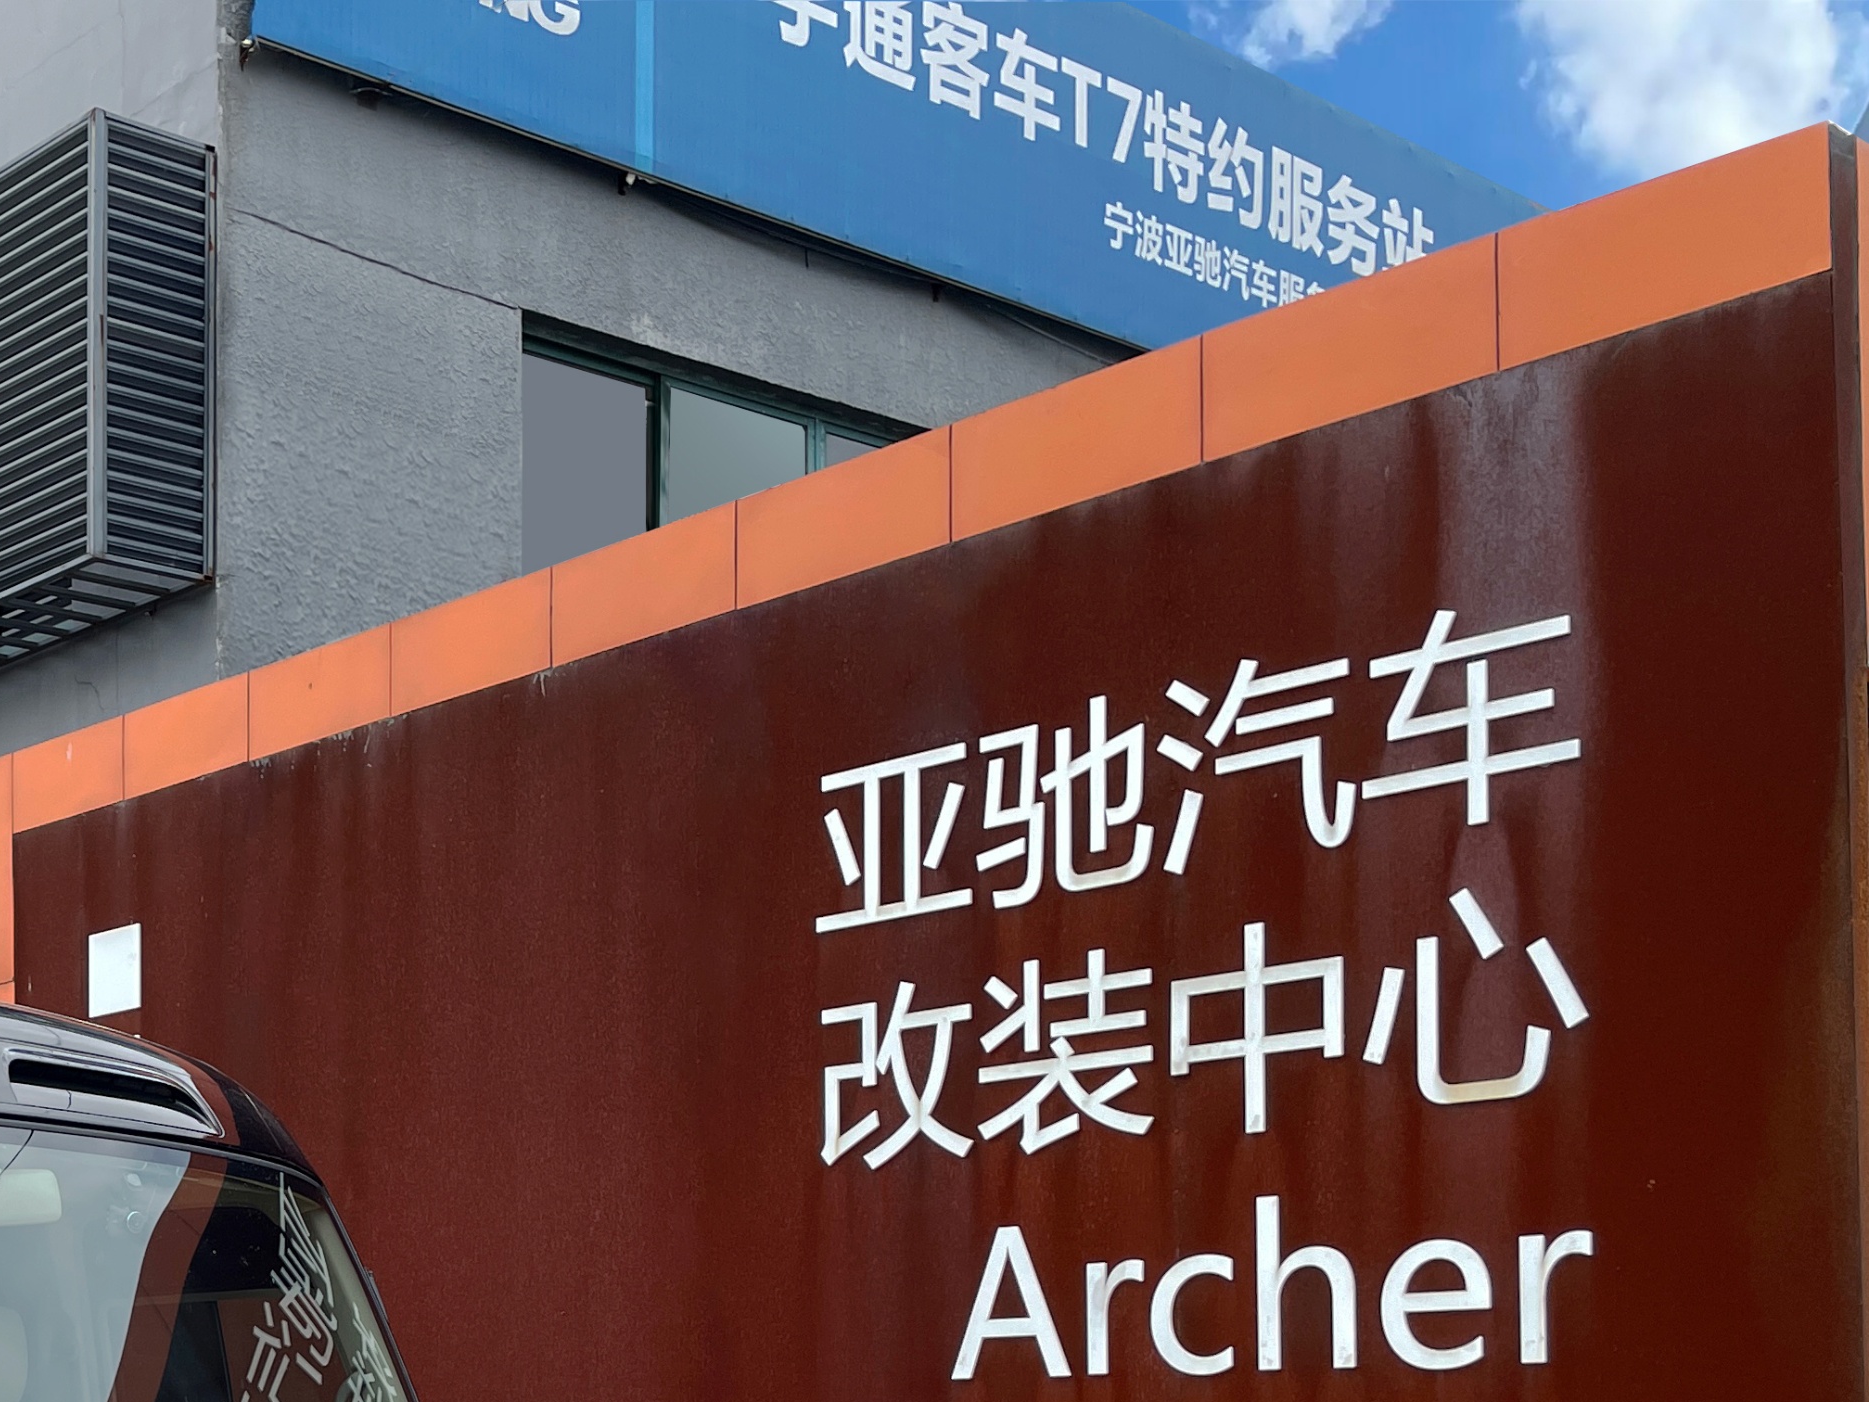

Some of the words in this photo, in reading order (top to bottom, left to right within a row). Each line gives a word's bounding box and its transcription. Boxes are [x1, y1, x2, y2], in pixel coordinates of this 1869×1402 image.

[816, 610, 1581, 933] 亚驰汽车
[820, 887, 1590, 1170] 改装中心
[951, 1195, 1593, 1381] Archer
